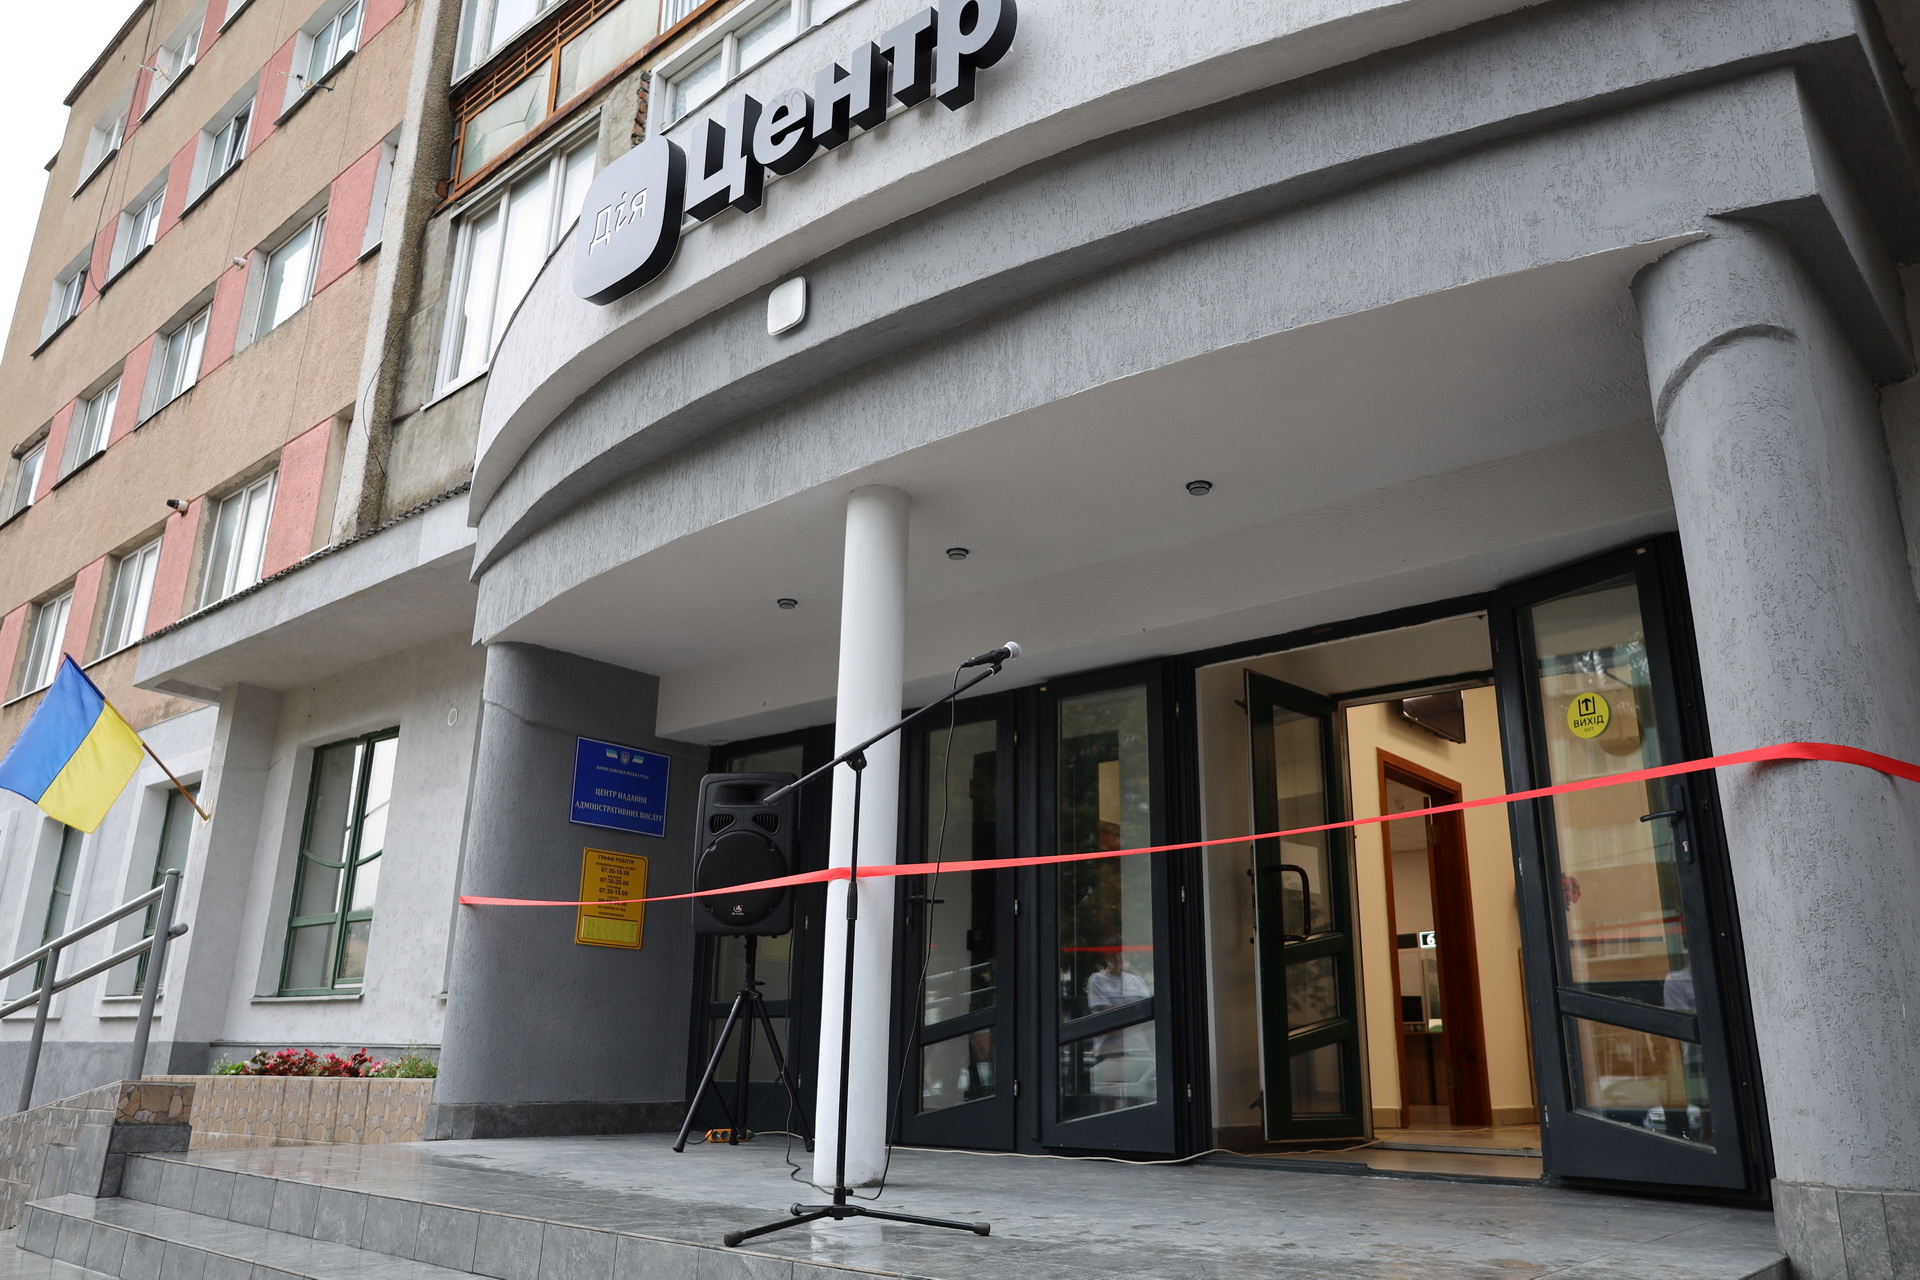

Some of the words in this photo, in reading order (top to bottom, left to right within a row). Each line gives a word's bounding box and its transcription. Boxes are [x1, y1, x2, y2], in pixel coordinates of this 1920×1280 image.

[588, 187, 648, 256] Дія
[685, 0, 1012, 220] Центр
[1573, 715, 1604, 728] ВИХІД
[595, 787, 617, 798] ЦЕНТР
[618, 792, 648, 804] НАДАННЯ
[575, 800, 639, 818] АДМІНІСТРАТИВНИХ
[640, 811, 663, 822] ПОСЛУГ
